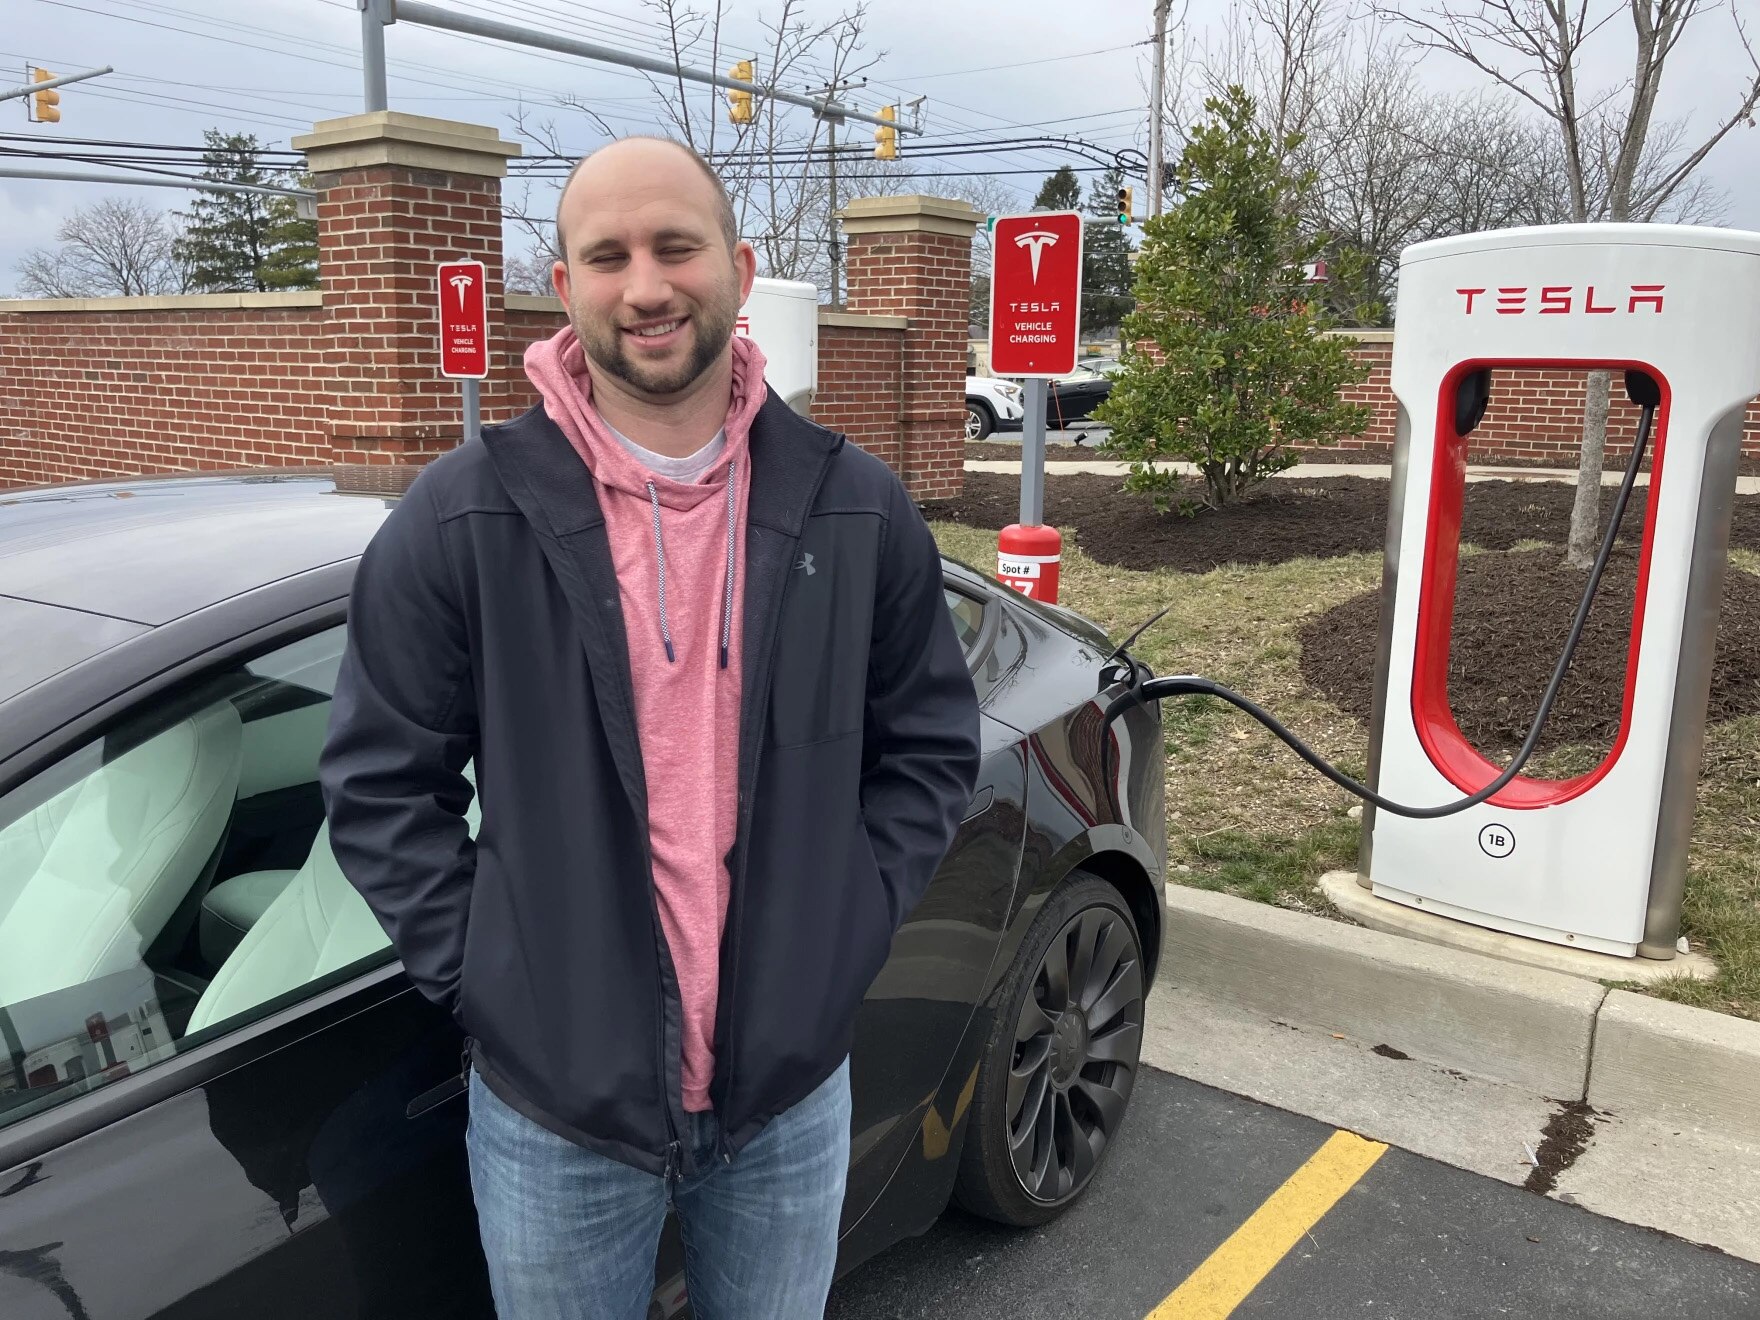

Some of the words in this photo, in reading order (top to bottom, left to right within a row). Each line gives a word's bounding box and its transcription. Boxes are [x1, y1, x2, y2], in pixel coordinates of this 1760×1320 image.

[1456, 285, 1665, 314] TESLA
[1009, 302, 1060, 313] TESLA
[449, 324, 477, 332] TESLA
[1014, 322, 1052, 331] VEHICLE
[1009, 334, 1057, 343] CHARGING
[1002, 563, 1021, 574] Spot
[1023, 566, 1030, 575] #
[1488, 833, 1505, 847] 1B
